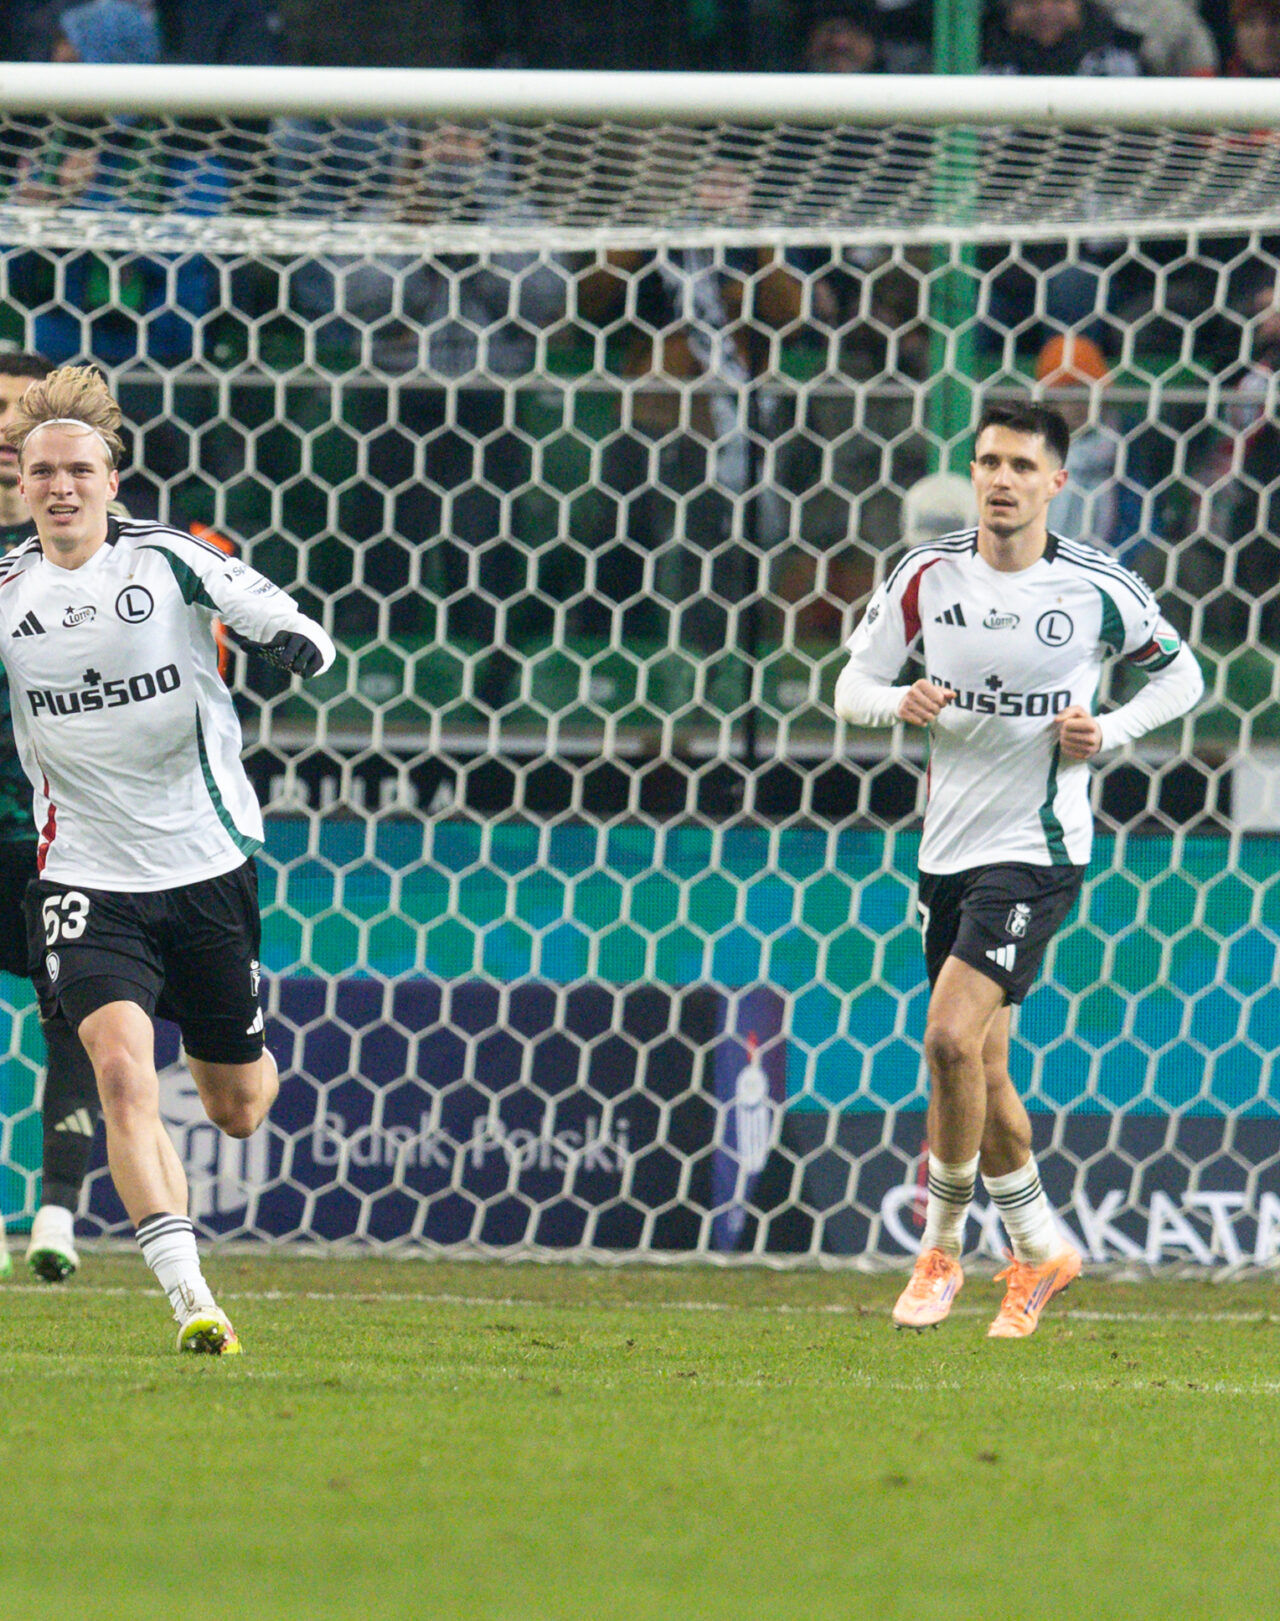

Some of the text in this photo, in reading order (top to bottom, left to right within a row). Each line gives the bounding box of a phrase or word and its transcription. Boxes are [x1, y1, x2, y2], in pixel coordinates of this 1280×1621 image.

[26, 664, 181, 717] Plus500
[42, 891, 90, 946] 53
[311, 1110, 631, 1173] Bank Polski
